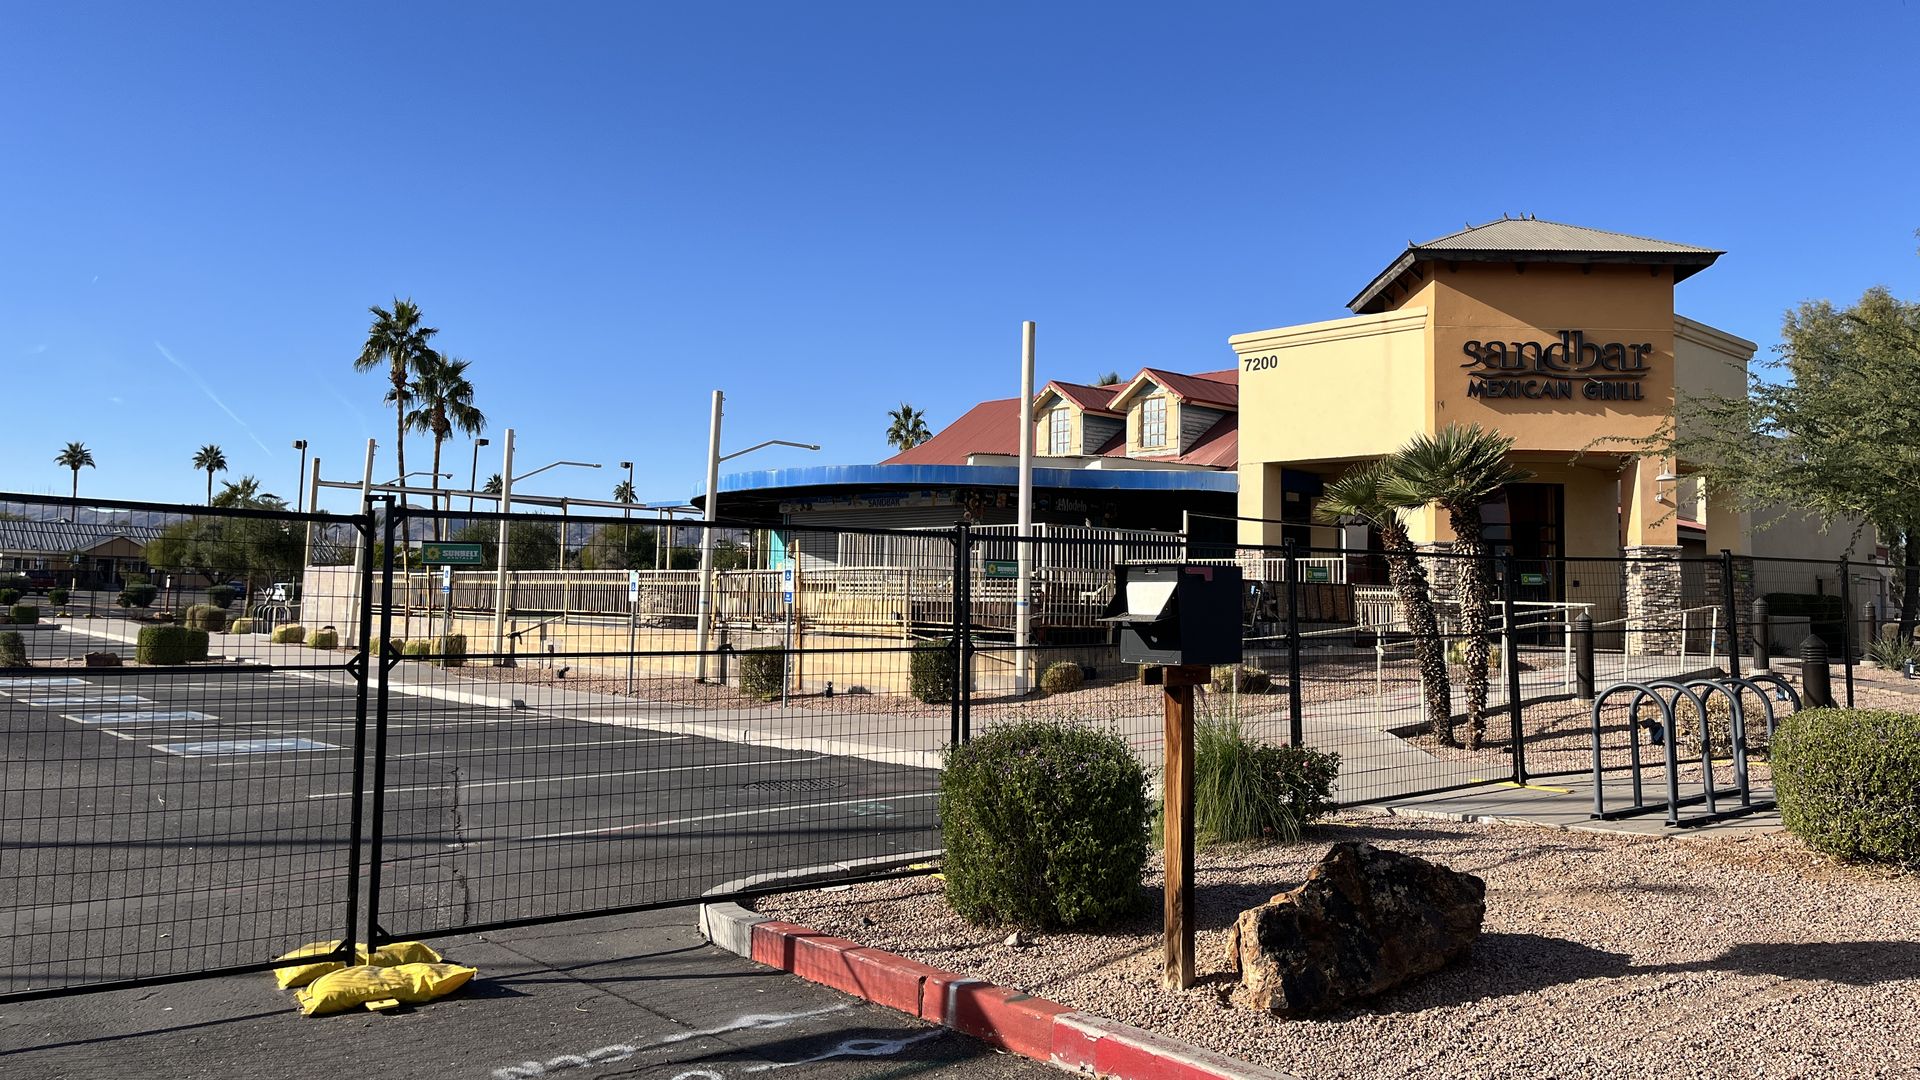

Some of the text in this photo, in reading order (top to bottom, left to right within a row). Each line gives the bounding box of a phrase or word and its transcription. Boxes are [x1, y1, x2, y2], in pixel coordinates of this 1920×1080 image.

[1460, 330, 1652, 371] sandbar
[1244, 355, 1278, 372] 7200
[1467, 379, 1645, 400] MEXICAN GRILL
